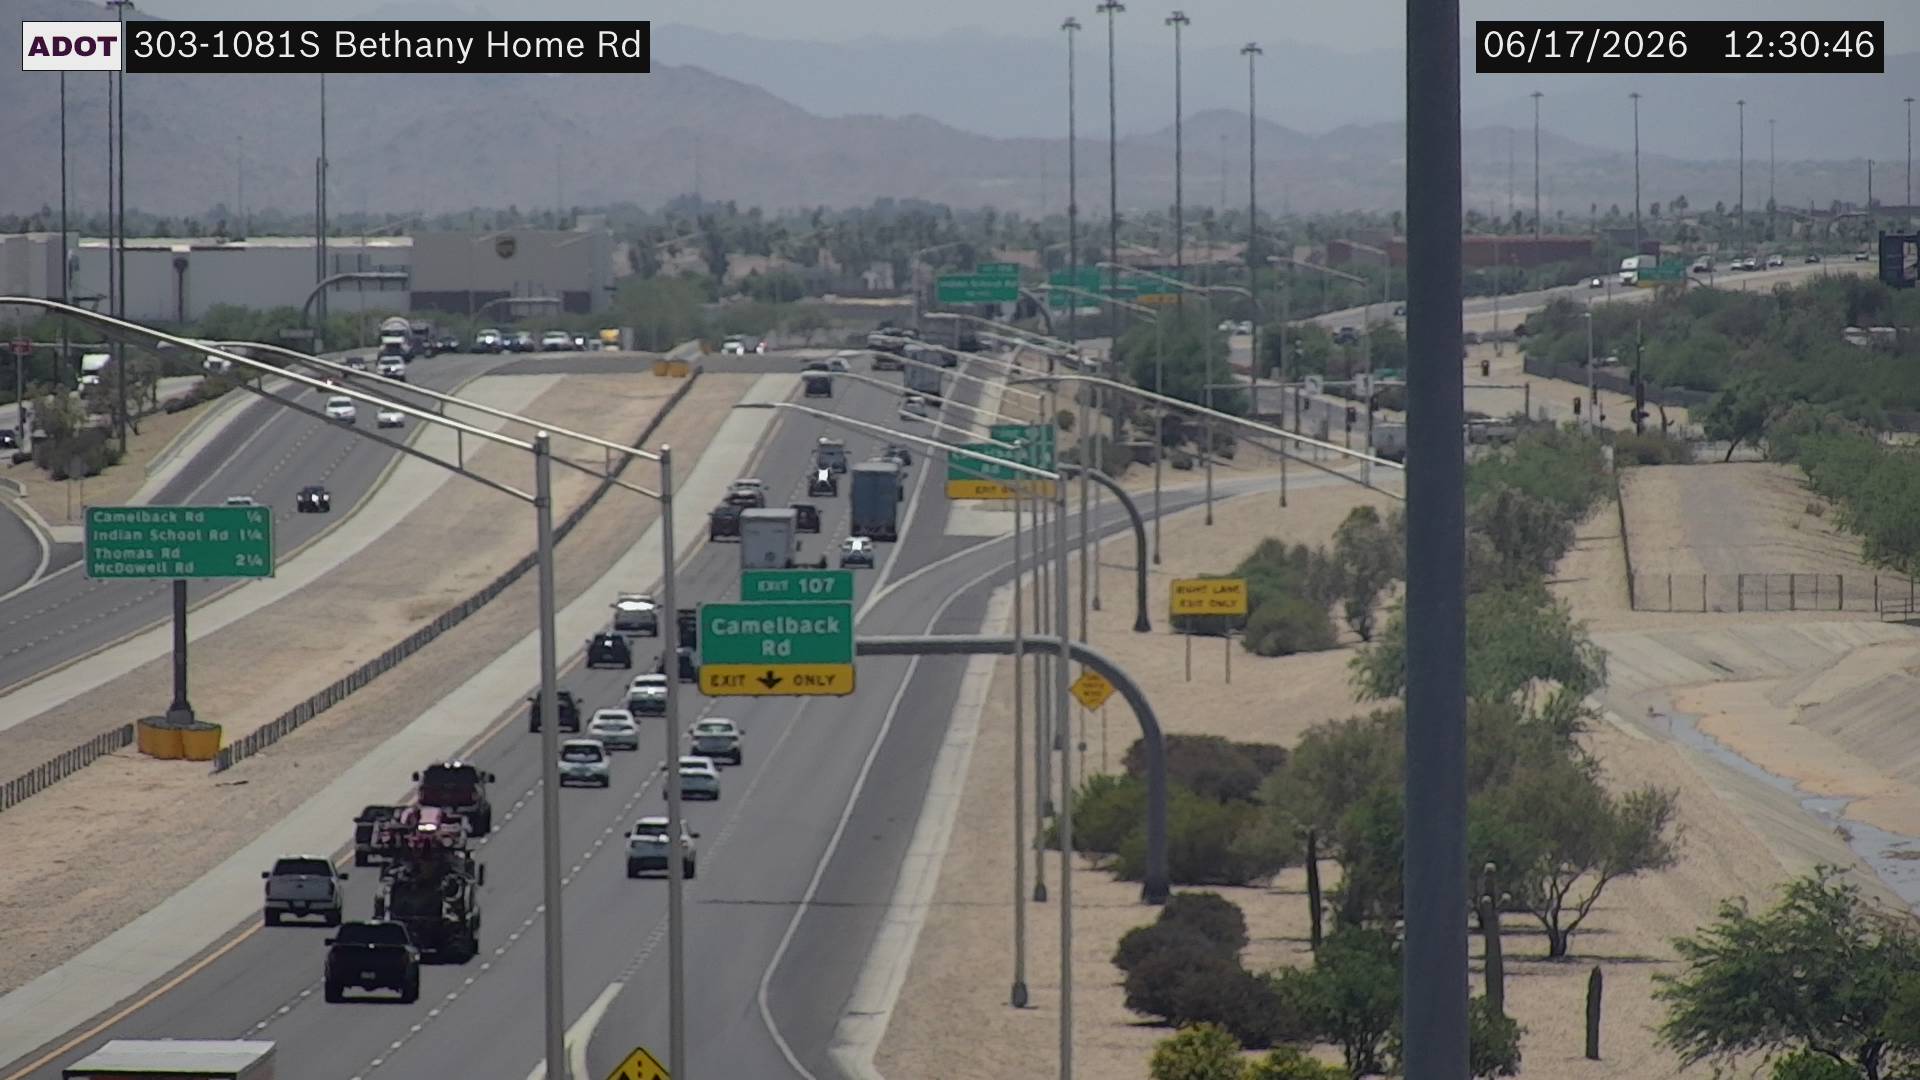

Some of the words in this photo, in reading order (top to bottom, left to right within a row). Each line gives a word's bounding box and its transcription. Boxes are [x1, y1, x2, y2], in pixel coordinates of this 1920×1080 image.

[94, 511, 177, 523] Camelback
[185, 511, 204, 523] Rd
[93, 529, 142, 541] Indian
[150, 528, 201, 541] School
[209, 529, 229, 541] Rd
[94, 547, 154, 560] Thomas
[161, 547, 180, 559] Rd
[94, 561, 168, 574] McDowell
[175, 561, 194, 574] Rd
[757, 580, 788, 593] EXIT
[799, 578, 835, 593] 107
[1210, 600, 1237, 608] ONLY
[711, 616, 840, 636] Camelback
[762, 639, 792, 656] Rd
[710, 674, 746, 687] EXIT
[793, 674, 836, 687] ONLY
